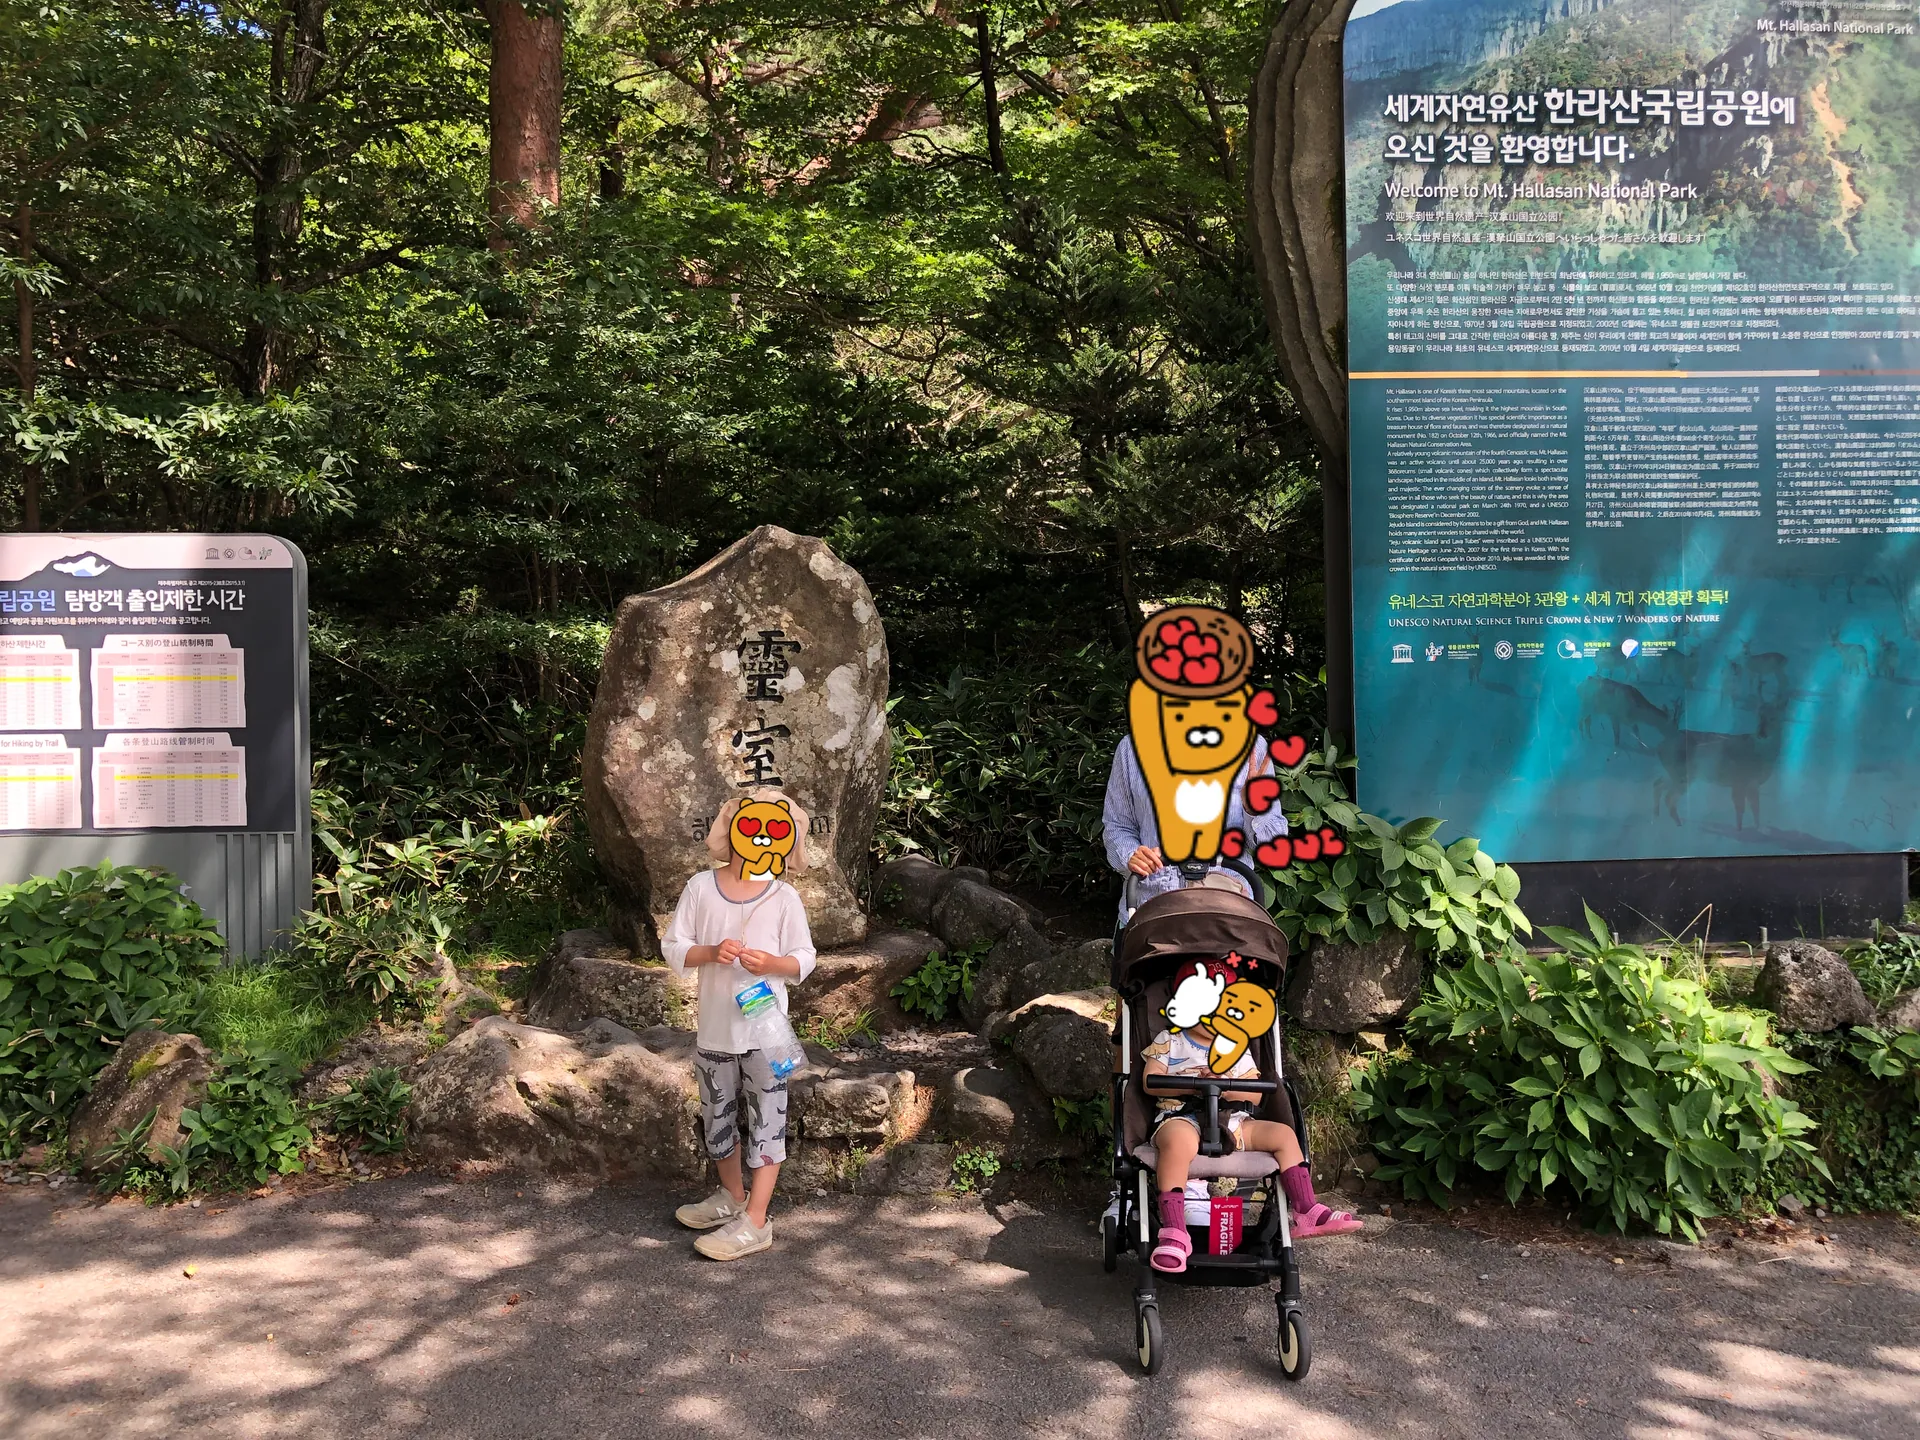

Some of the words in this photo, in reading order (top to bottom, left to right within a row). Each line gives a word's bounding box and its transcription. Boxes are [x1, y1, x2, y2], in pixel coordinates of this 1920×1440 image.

[1757, 19, 1776, 31] Mt.
[1780, 20, 1830, 32] Hallasan
[1834, 21, 1883, 33] National
[1887, 23, 1913, 34] Park
[1383, 94, 1539, 123] 세계자연유산
[1544, 88, 1795, 126] 한라산국립공원에
[1384, 134, 1435, 163] 오신
[1444, 135, 1494, 163] 것을
[1501, 134, 1634, 164] 환영합니다.
[1385, 183, 1459, 198] Welcome
[1464, 184, 1477, 198] to
[1484, 183, 1508, 198] Mt.
[1514, 183, 1583, 198] Hallasan
[1589, 183, 1655, 198] National
[1660, 183, 1698, 198] Park
[65, 589, 122, 612] 탐방객
[126, 589, 204, 612] 출입제한
[206, 589, 245, 611] 시간
[1388, 593, 1445, 610] 유네스코
[1448, 592, 1530, 608] 자연과학분야
[1534, 592, 1568, 607] 3관왕
[1584, 591, 1611, 606] 세계
[1616, 591, 1634, 606] 7대
[1639, 590, 1693, 606] 자연경관
[1696, 590, 1729, 605] 획득!
[1388, 618, 1429, 627] UNESCO
[1433, 617, 1472, 626] NATURAL
[1476, 617, 1512, 625] SCIENCE
[1515, 616, 1543, 624] TRIPLE
[1546, 616, 1581, 624] CROWN
[1594, 615, 1614, 623] NEW
[1617, 615, 1621, 623] 7
[1624, 615, 1668, 623] WONDERS
[12, 740, 33, 748] Hiking
[1220, 1212, 1228, 1255] FRAGILE
